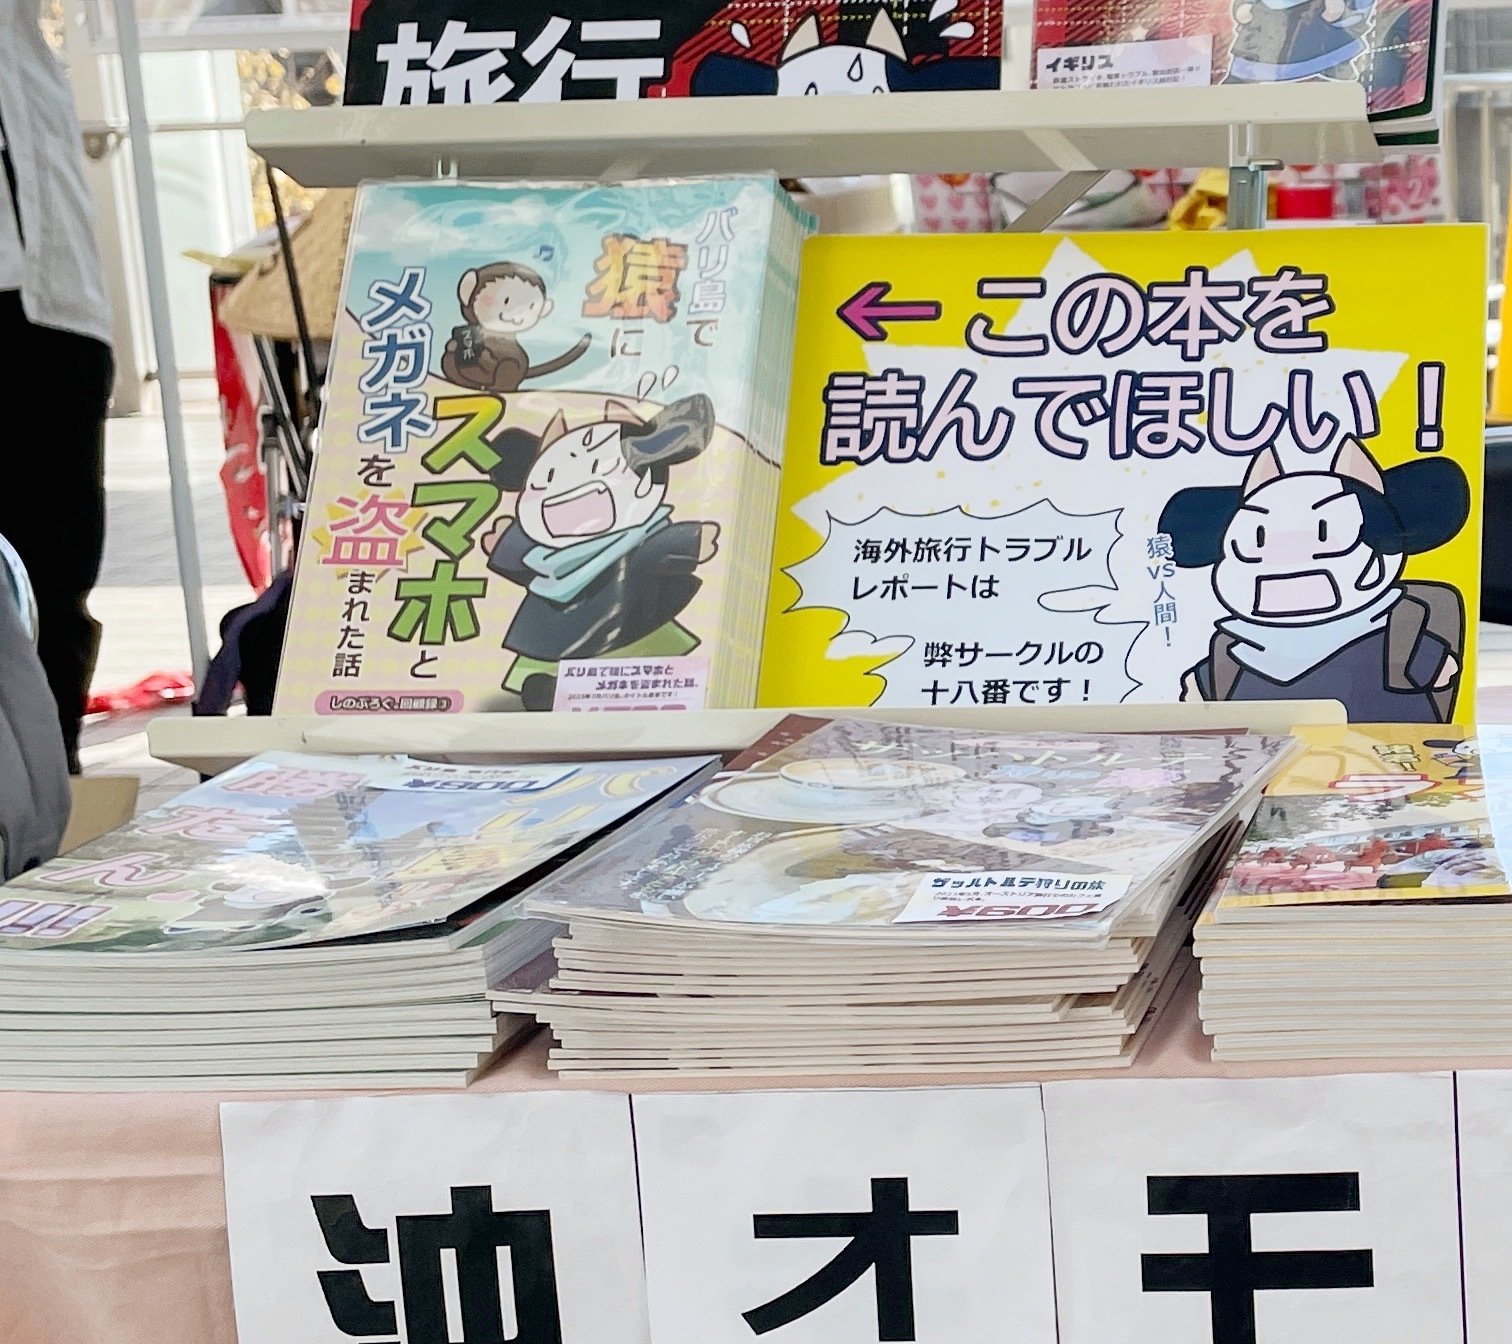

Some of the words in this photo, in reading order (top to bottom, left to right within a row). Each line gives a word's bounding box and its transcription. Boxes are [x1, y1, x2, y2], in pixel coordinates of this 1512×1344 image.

[376, 16, 665, 105] 旅行
[1046, 54, 1115, 73] イギリス
[581, 234, 689, 359] 猿に
[686, 207, 738, 348] バリ島で
[965, 264, 1337, 361] この本を
[819, 361, 1448, 465] 読んでほしい！
[320, 266, 439, 680] メガネを盗まれた話
[387, 393, 507, 681] スマホと
[852, 534, 1093, 564] 海外旅行トラブル
[852, 572, 1000, 602] レポートは
[921, 675, 1093, 706] 十八番です！
[922, 639, 1104, 669] 弊サークルの
[937, 903, 1099, 918] ¥600
